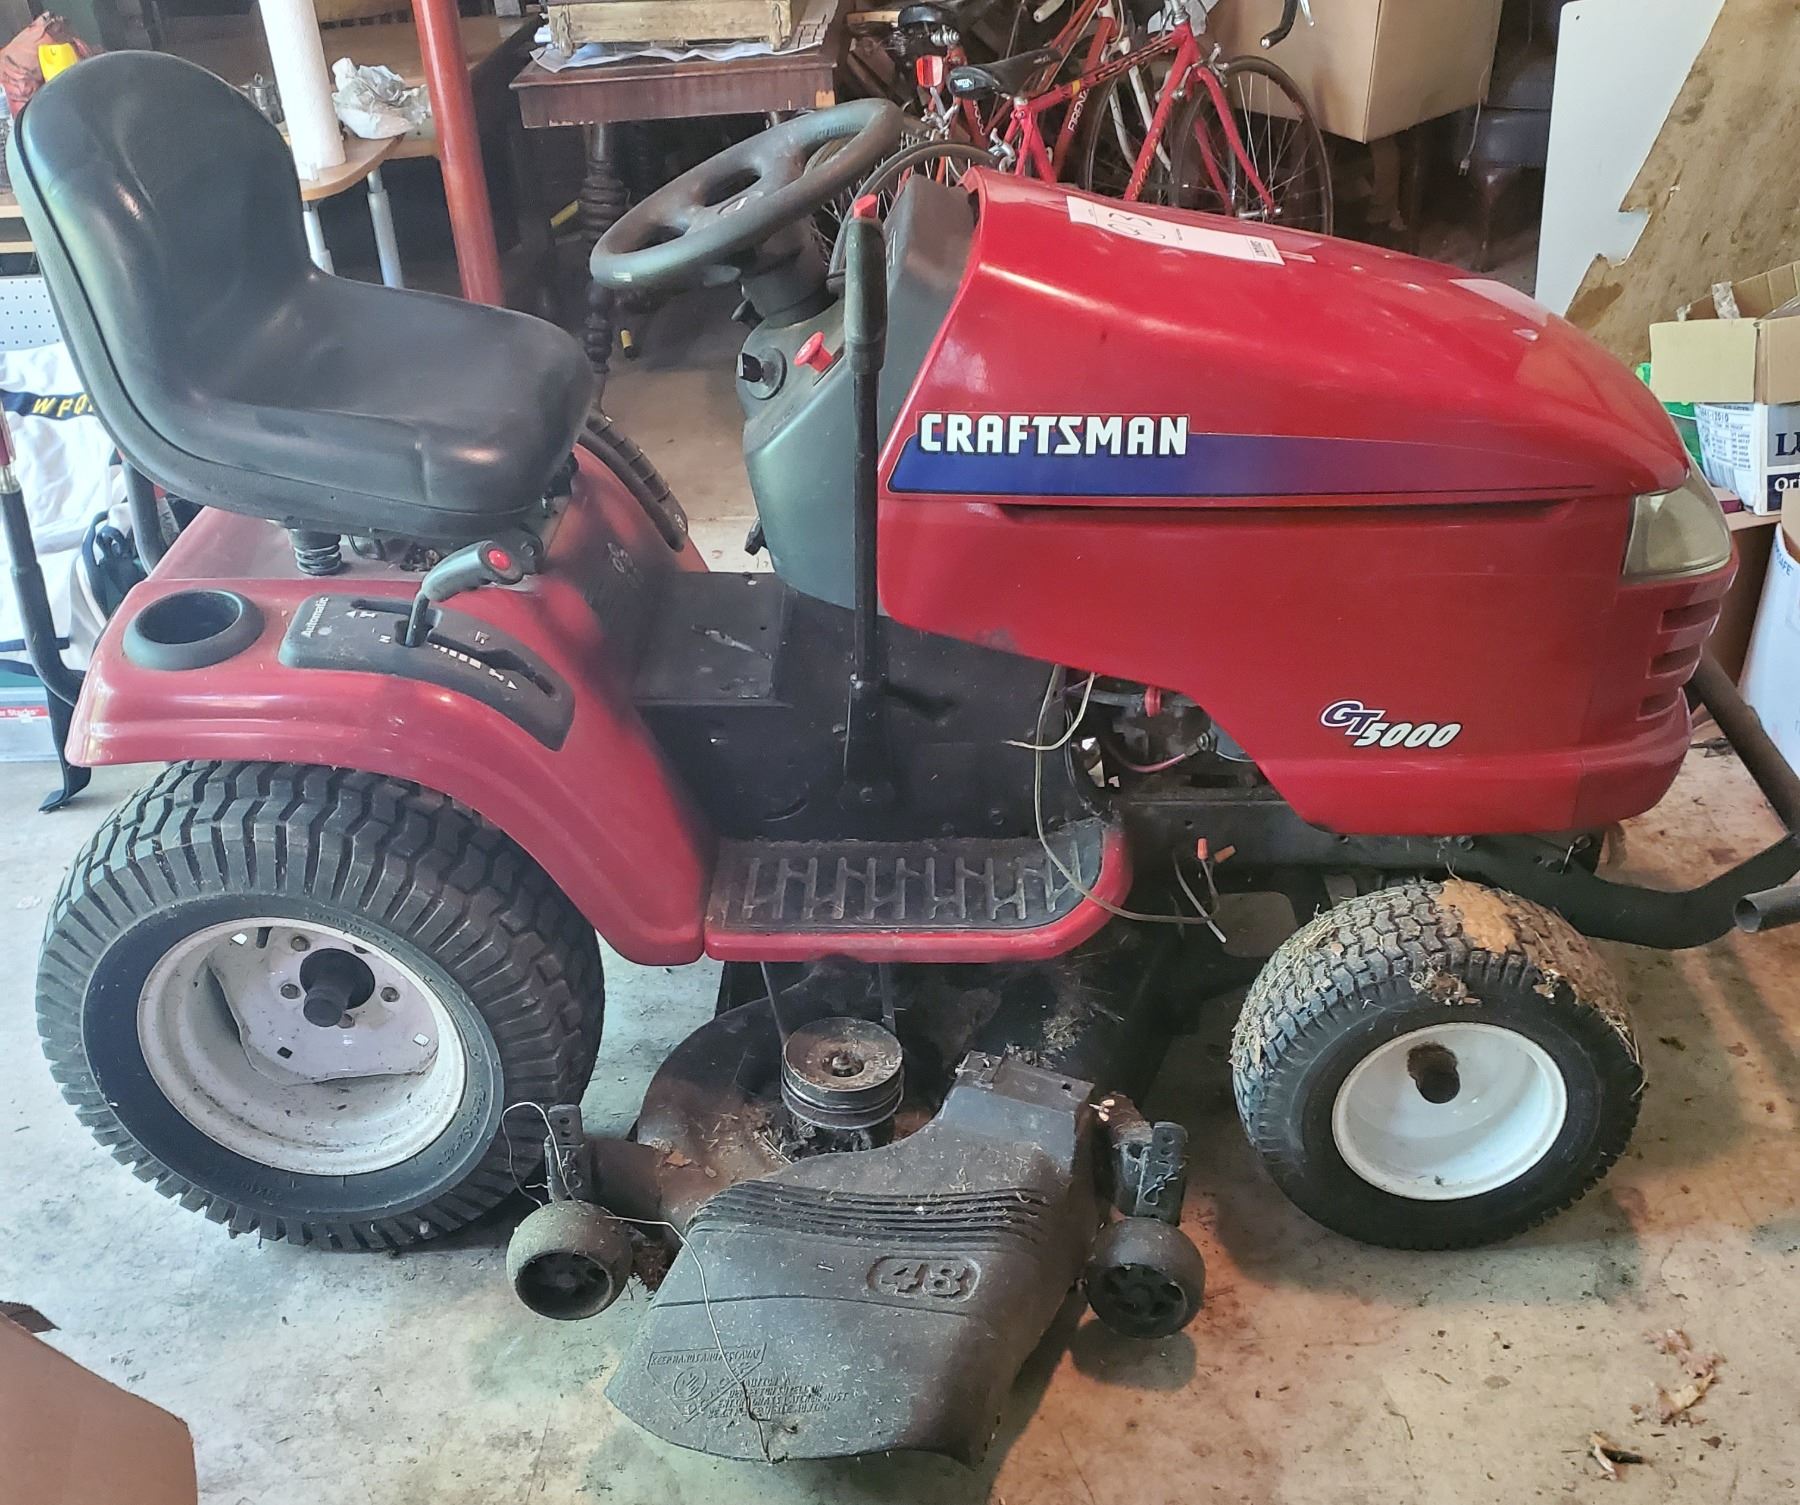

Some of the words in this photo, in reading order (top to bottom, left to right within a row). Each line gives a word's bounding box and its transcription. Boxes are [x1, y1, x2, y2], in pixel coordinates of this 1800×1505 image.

[920, 412, 1189, 456] CRAFTSMAN
[300, 597, 329, 639] Automatic
[1320, 699, 1387, 736] GT
[1353, 721, 1463, 748] 5000
[879, 1261, 971, 1299] 48
